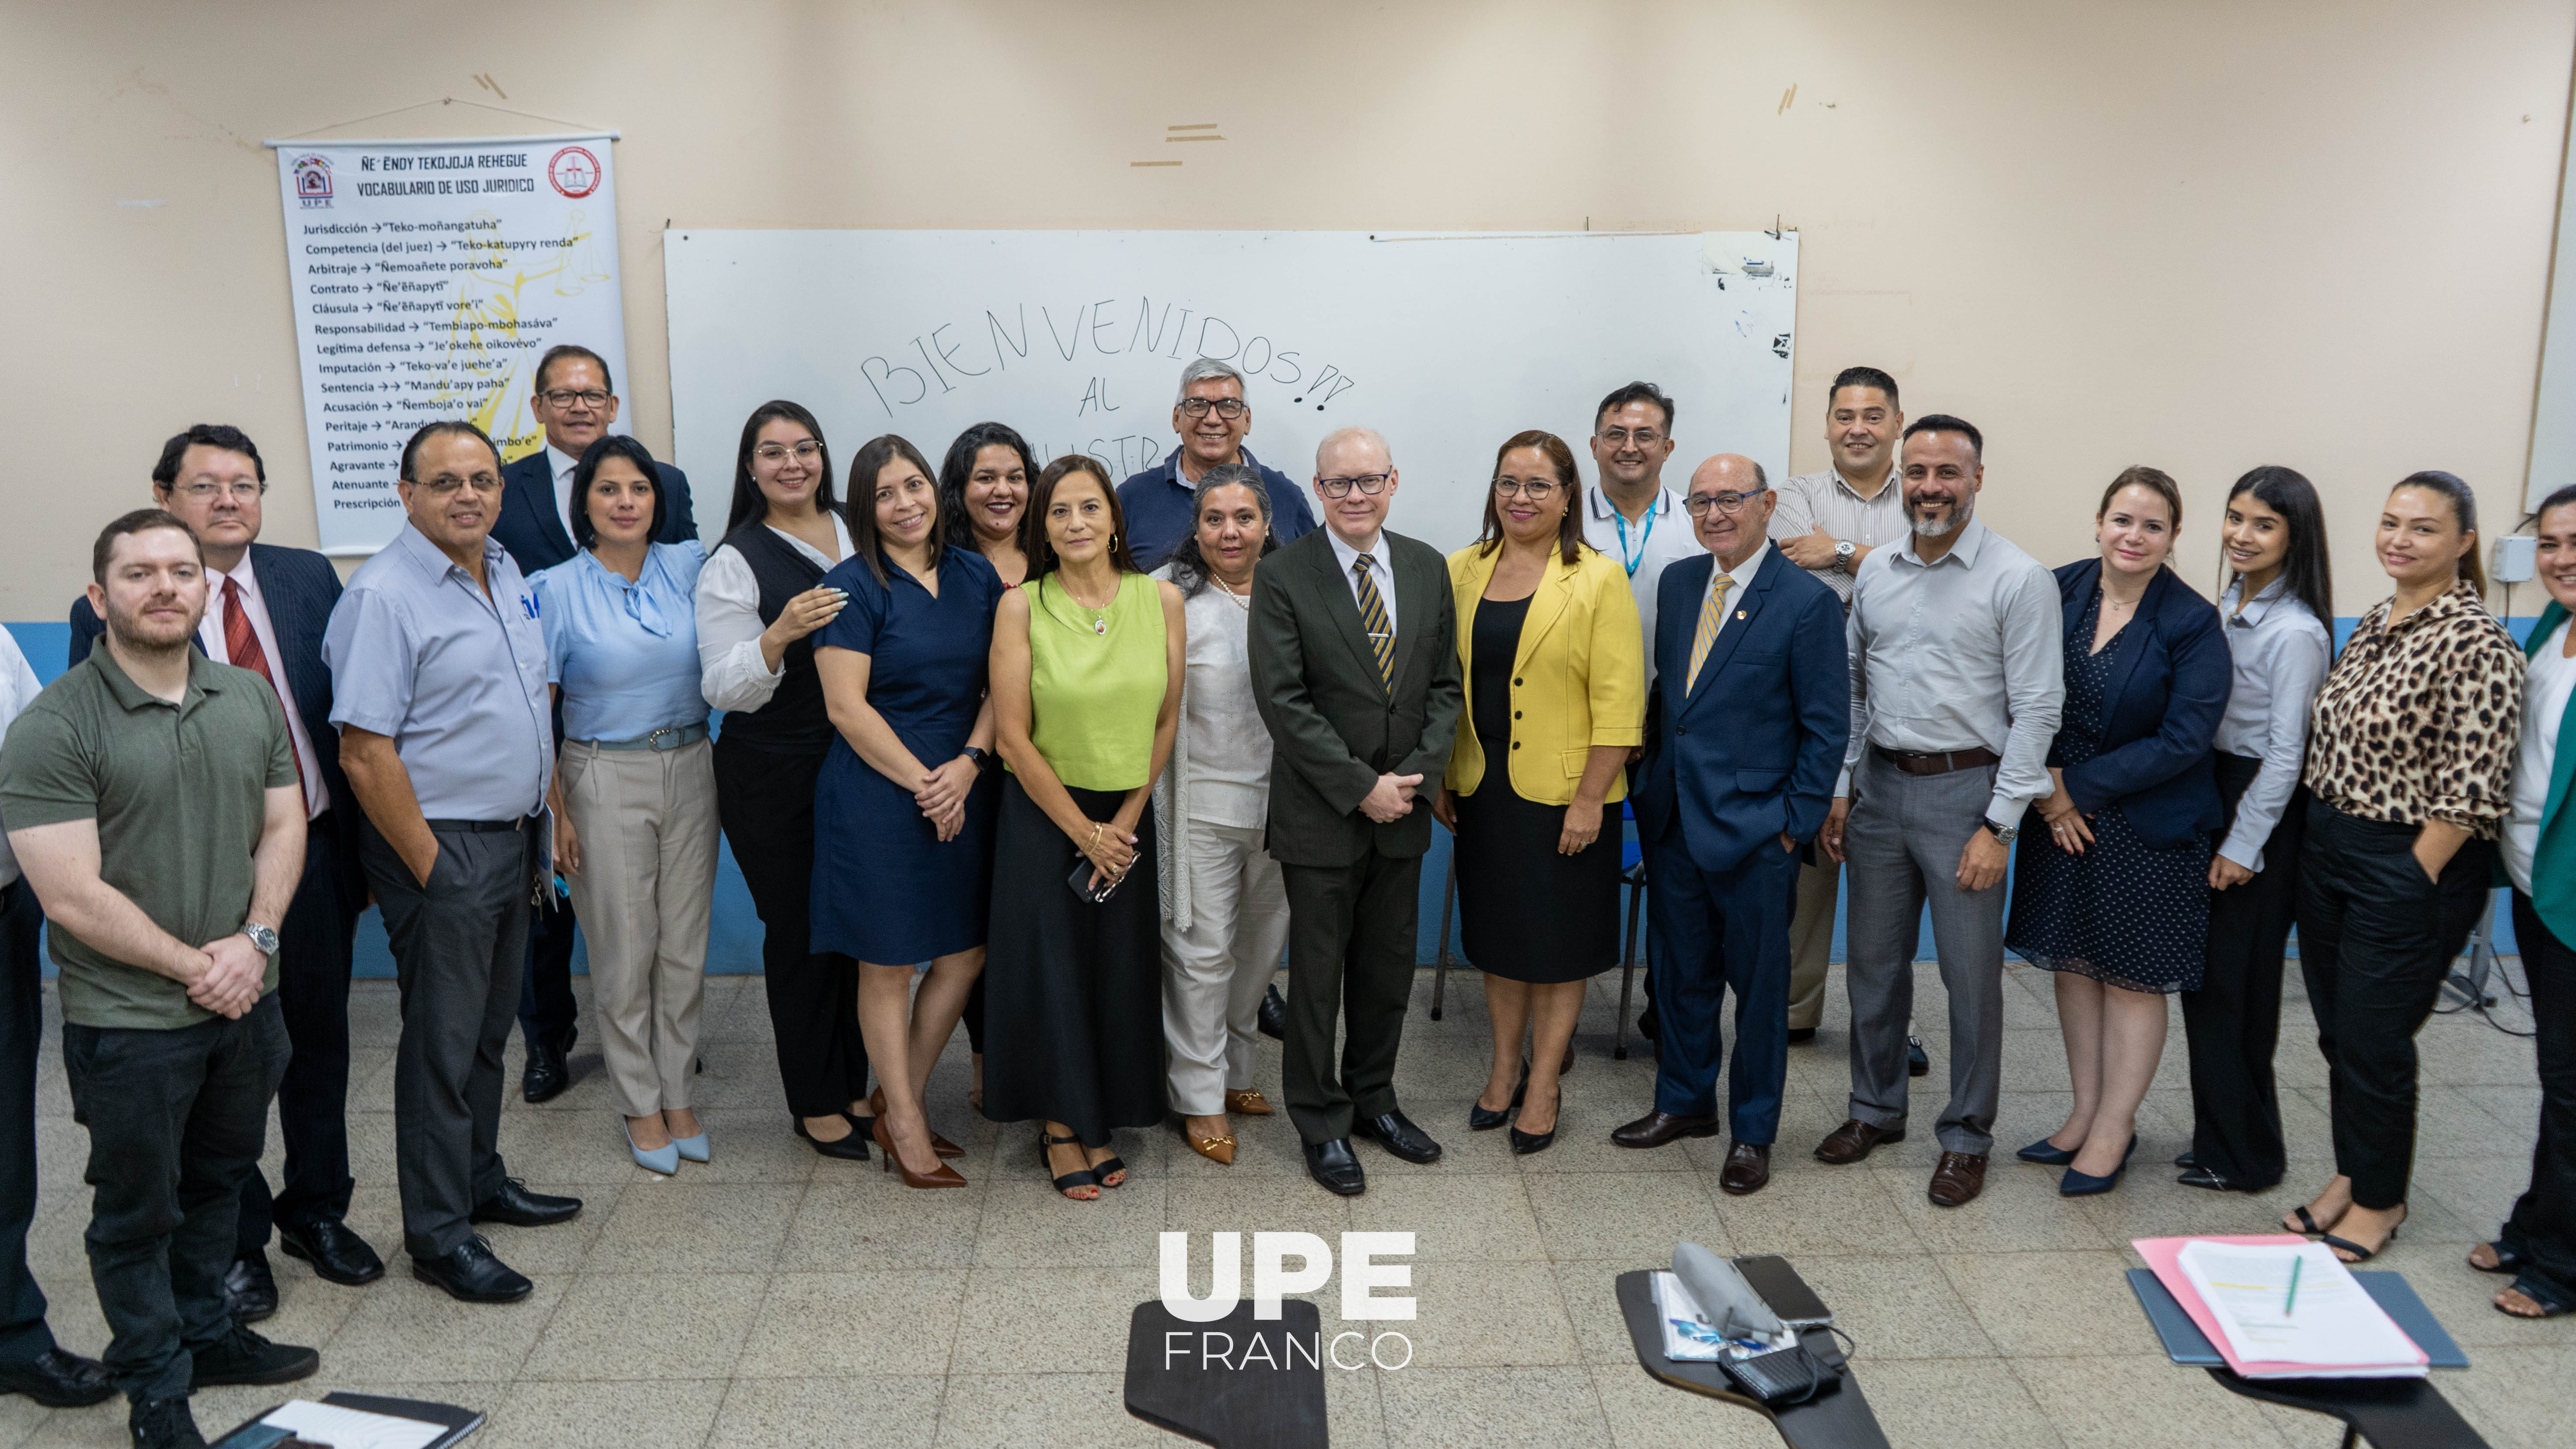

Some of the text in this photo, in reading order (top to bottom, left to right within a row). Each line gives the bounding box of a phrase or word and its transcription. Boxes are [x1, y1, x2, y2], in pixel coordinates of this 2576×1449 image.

[418, 156, 474, 169] TEKOJOJA
[478, 154, 528, 168] REHEGUE
[357, 178, 534, 196] VOCABULARIO DE USO JURIDICO
[304, 223, 368, 235] Jurisdicción
[306, 243, 378, 256] Competencia
[382, 243, 402, 254] (del
[406, 241, 432, 253] juez)
[308, 263, 357, 275] Arbitraje
[310, 284, 358, 294] Contrato
[313, 303, 359, 314] Cláusula
[315, 322, 405, 336] Responsabilidad
[317, 343, 363, 356] Legítima
[367, 342, 411, 353] defensa
[319, 362, 381, 376] Imputación
[321, 382, 374, 393] Sentencia
[1079, 377, 1120, 417] AL
[324, 402, 378, 412] Acusación
[325, 421, 368, 433] Peritaje
[328, 441, 388, 451] Patrimonio
[330, 461, 385, 473] Agravante
[332, 480, 389, 490] Atenuante
[334, 497, 401, 510] Prescripción
